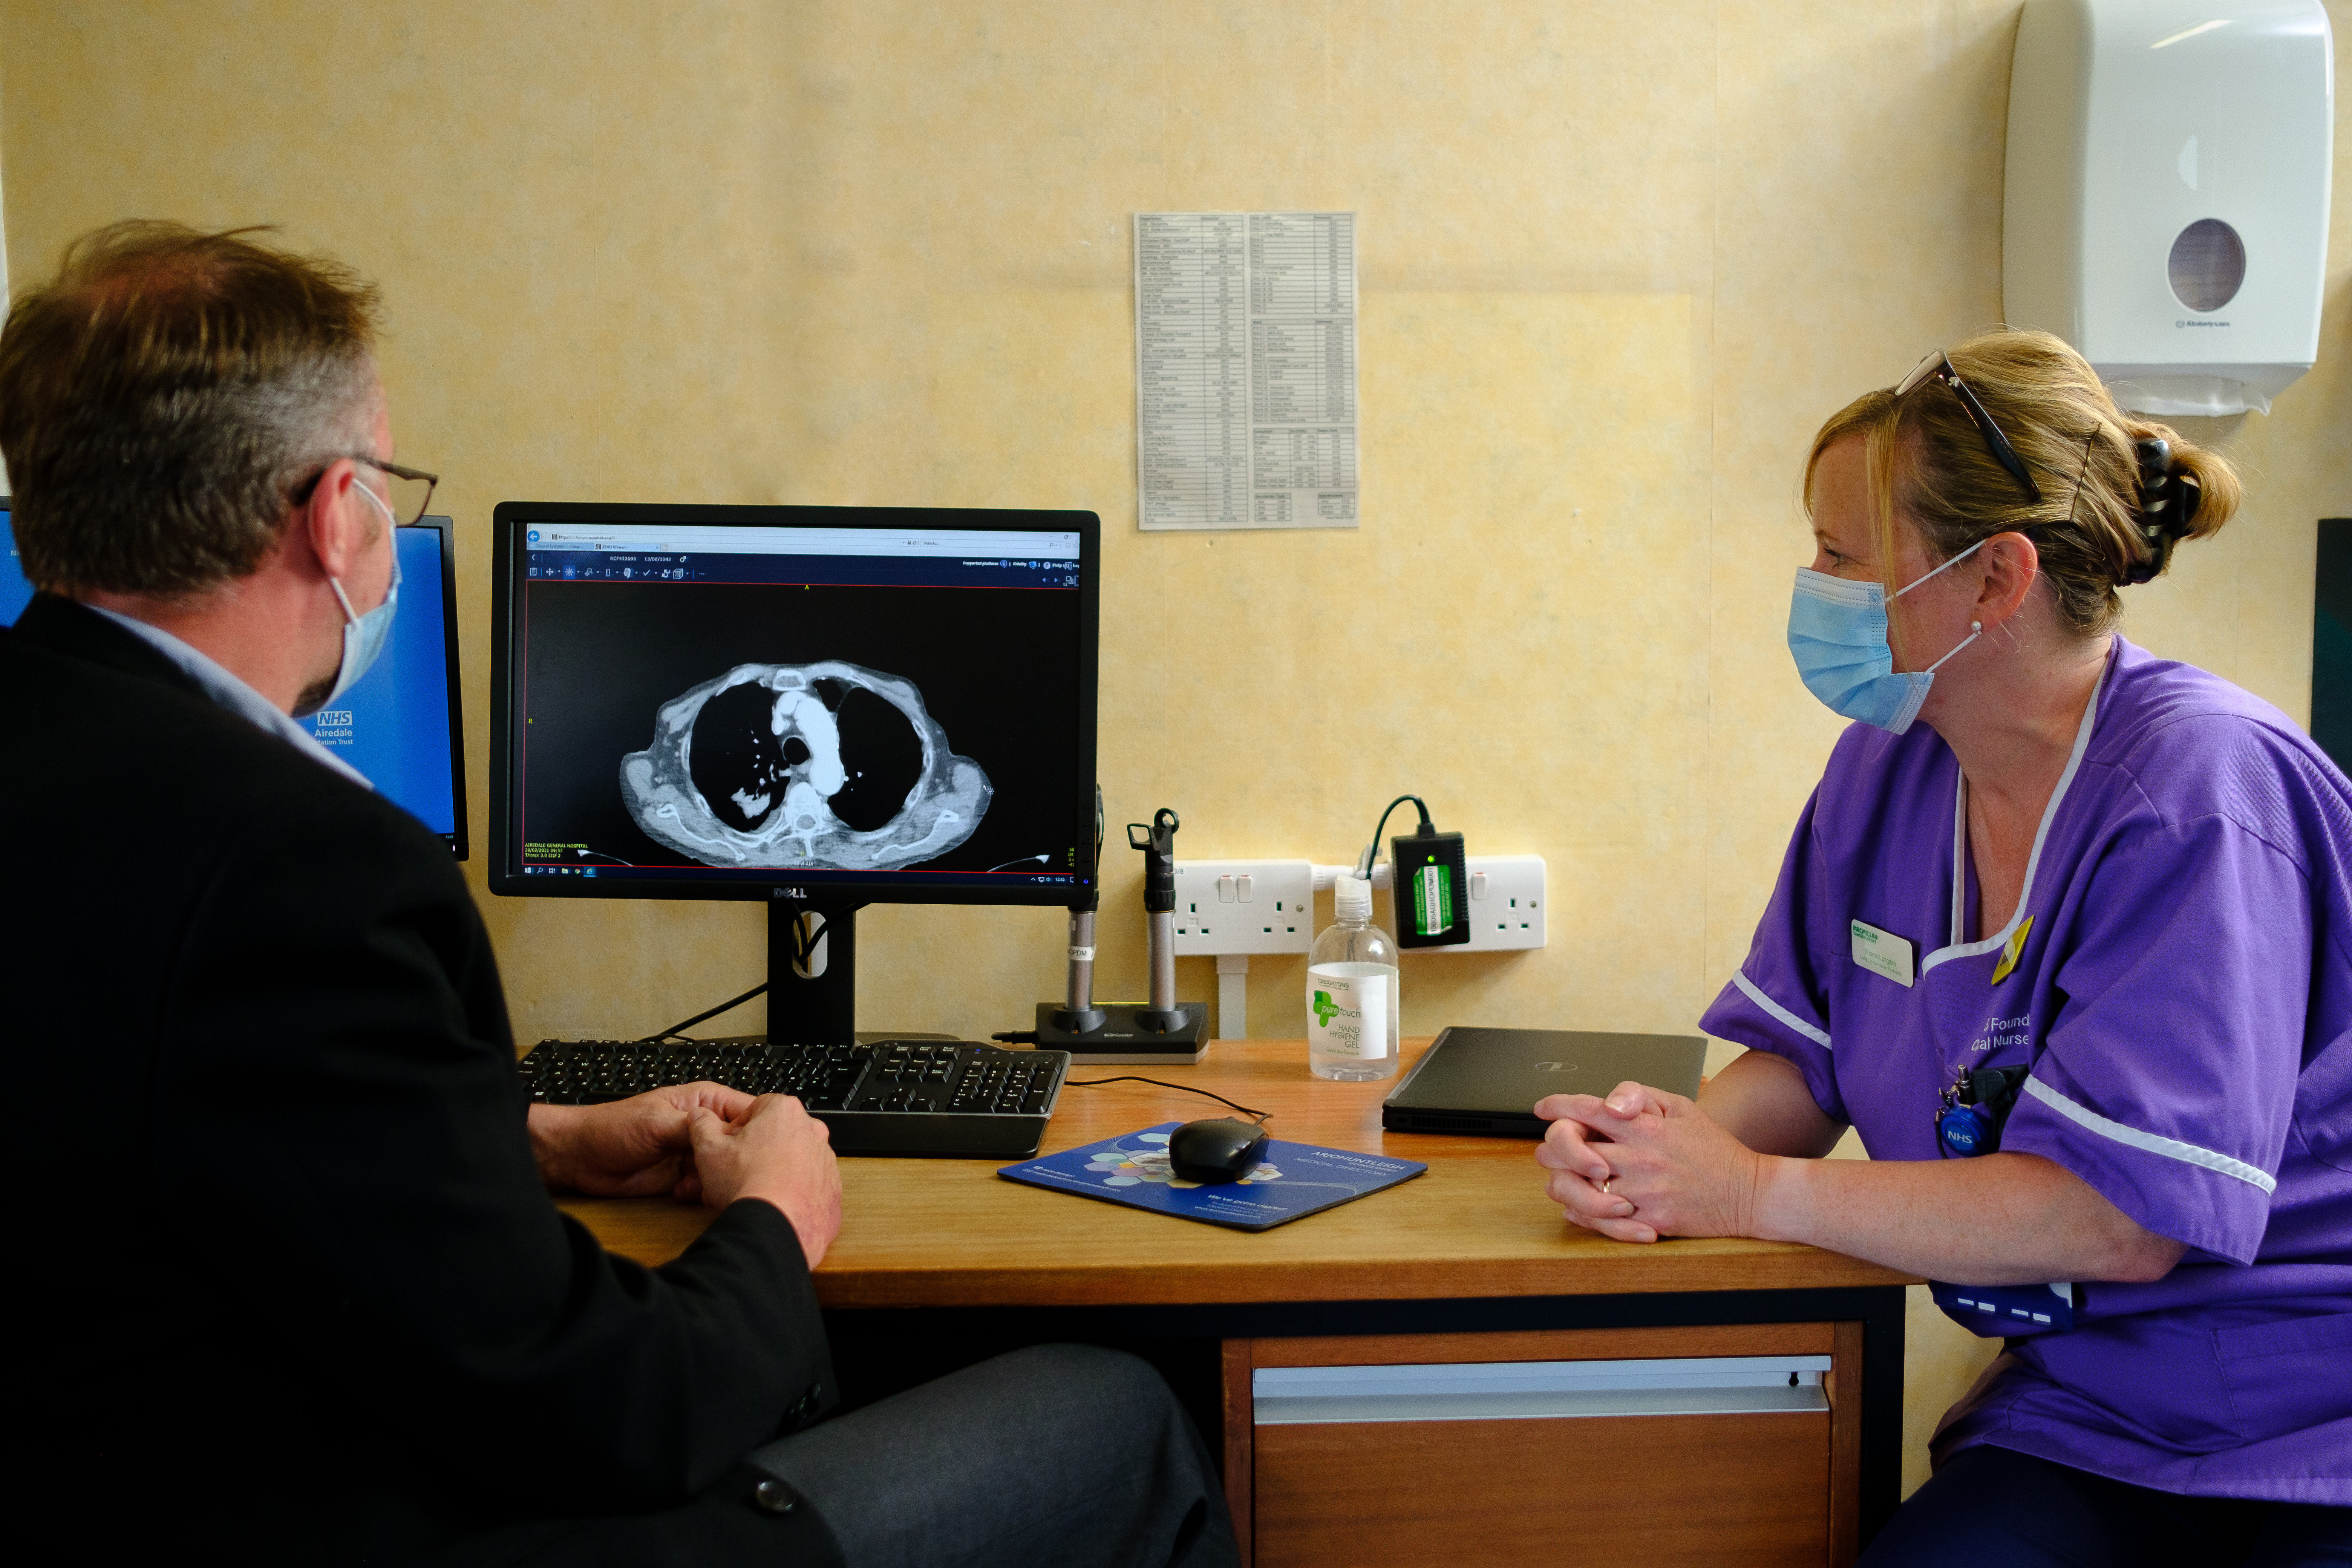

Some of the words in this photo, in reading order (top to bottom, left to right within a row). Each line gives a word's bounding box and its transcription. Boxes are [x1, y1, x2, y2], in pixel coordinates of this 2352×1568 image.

[319, 712, 350, 724] NHS
[315, 728, 353, 737] Airedale
[774, 887, 807, 899] DELL
[1853, 925, 1878, 940] MACMILLAN
[1317, 978, 1350, 988] CREIGHTONS
[1338, 1024, 1360, 1034] HAND
[1329, 1031, 1360, 1041] HYGIENE
[1994, 1035, 2029, 1048] Nurse
[1948, 1130, 1973, 1144] NHS
